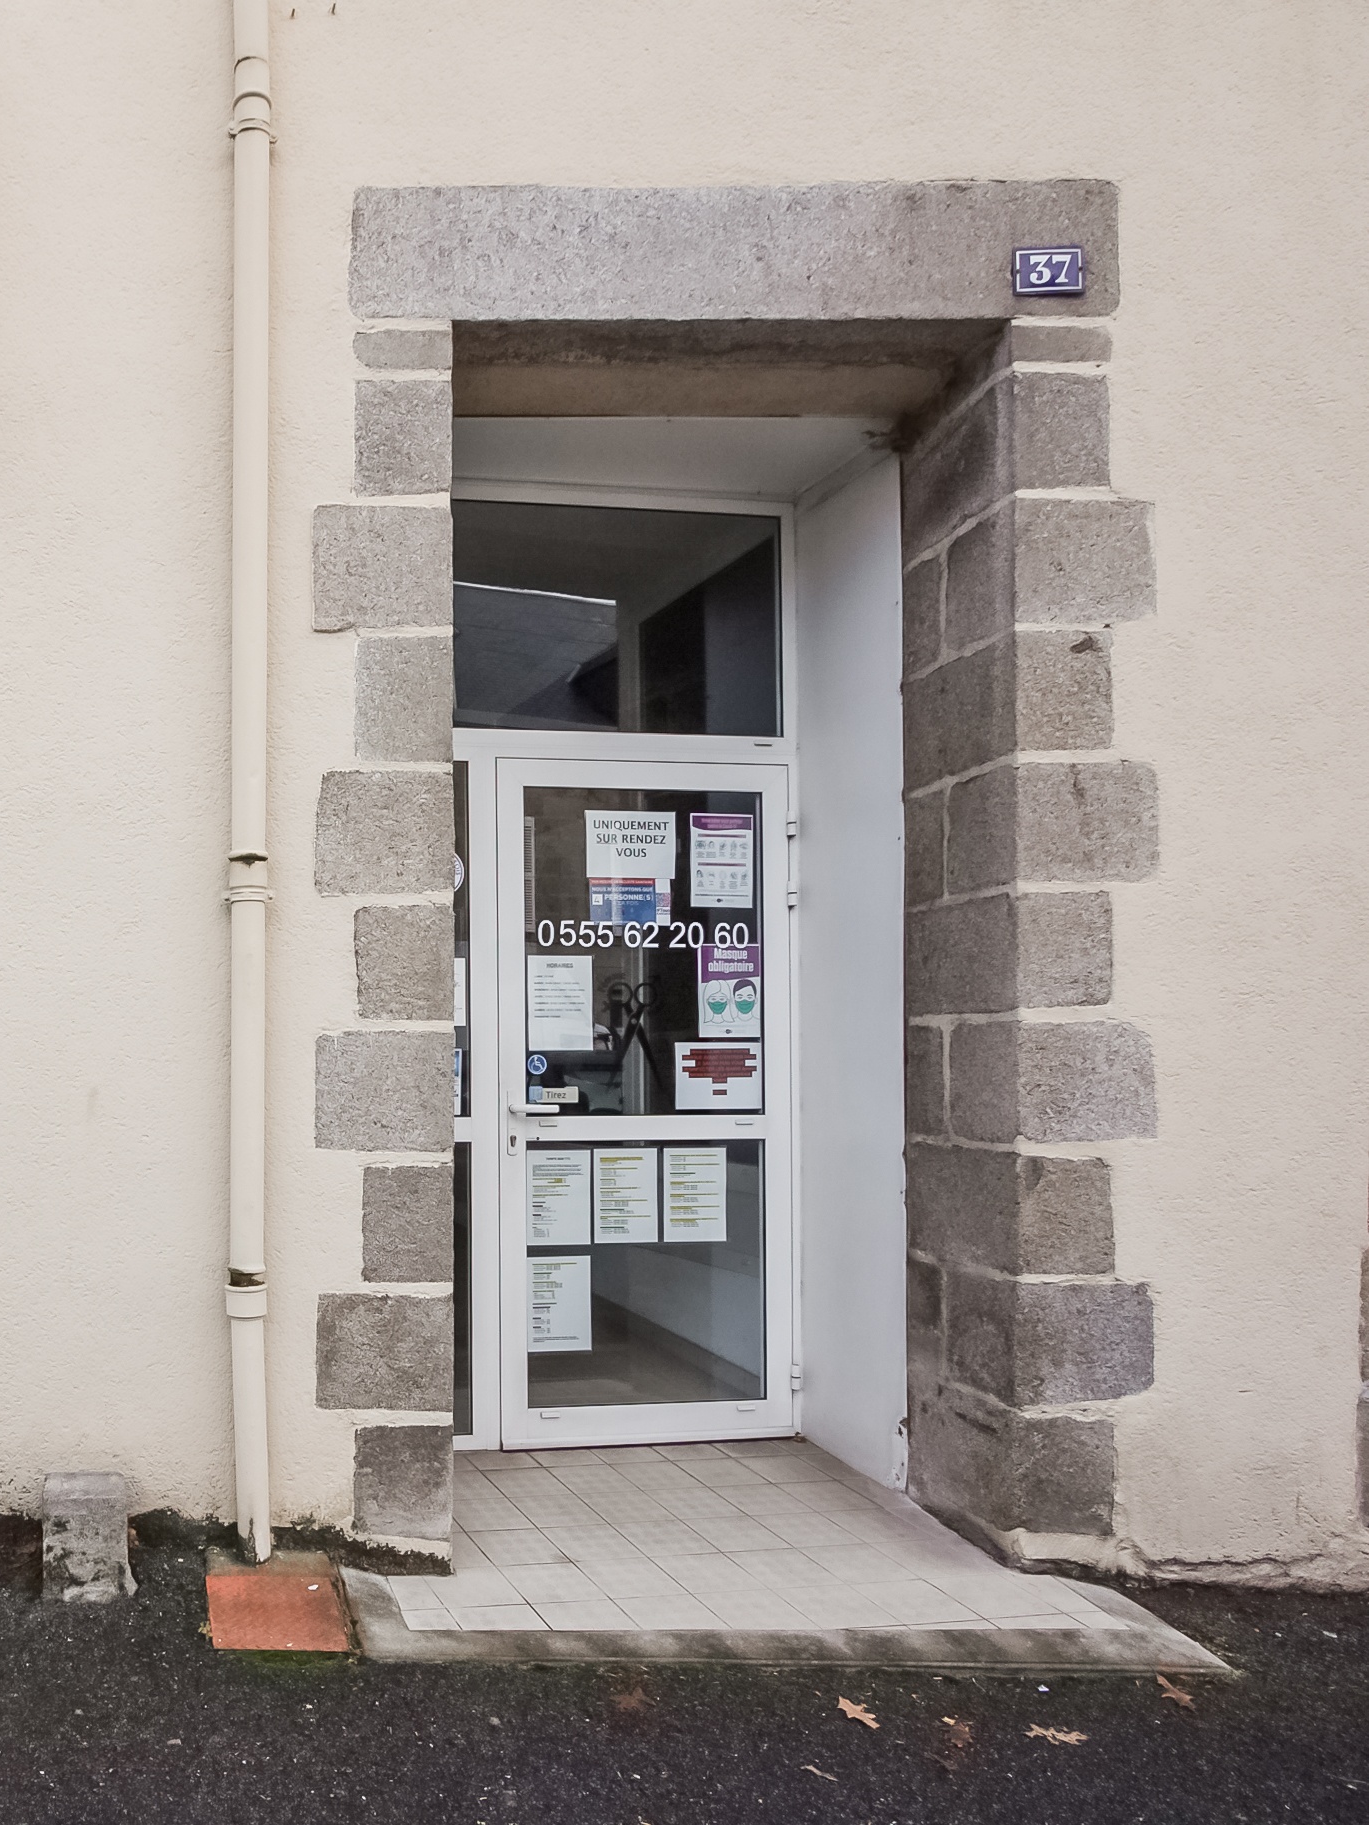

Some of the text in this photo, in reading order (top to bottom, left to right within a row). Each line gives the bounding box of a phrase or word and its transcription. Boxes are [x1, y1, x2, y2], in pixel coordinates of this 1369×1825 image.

[1029, 254, 1072, 284] 37
[593, 820, 669, 831] UNIQUEMENT
[596, 833, 666, 844] SUR RENDEZ
[615, 847, 647, 858] VOUS
[624, 921, 659, 948] 62
[669, 922, 704, 948] 20
[714, 923, 749, 948] 60
[714, 948, 748, 960] Masque
[708, 960, 754, 973] obligatoire
[545, 1091, 566, 1099] Tirez
